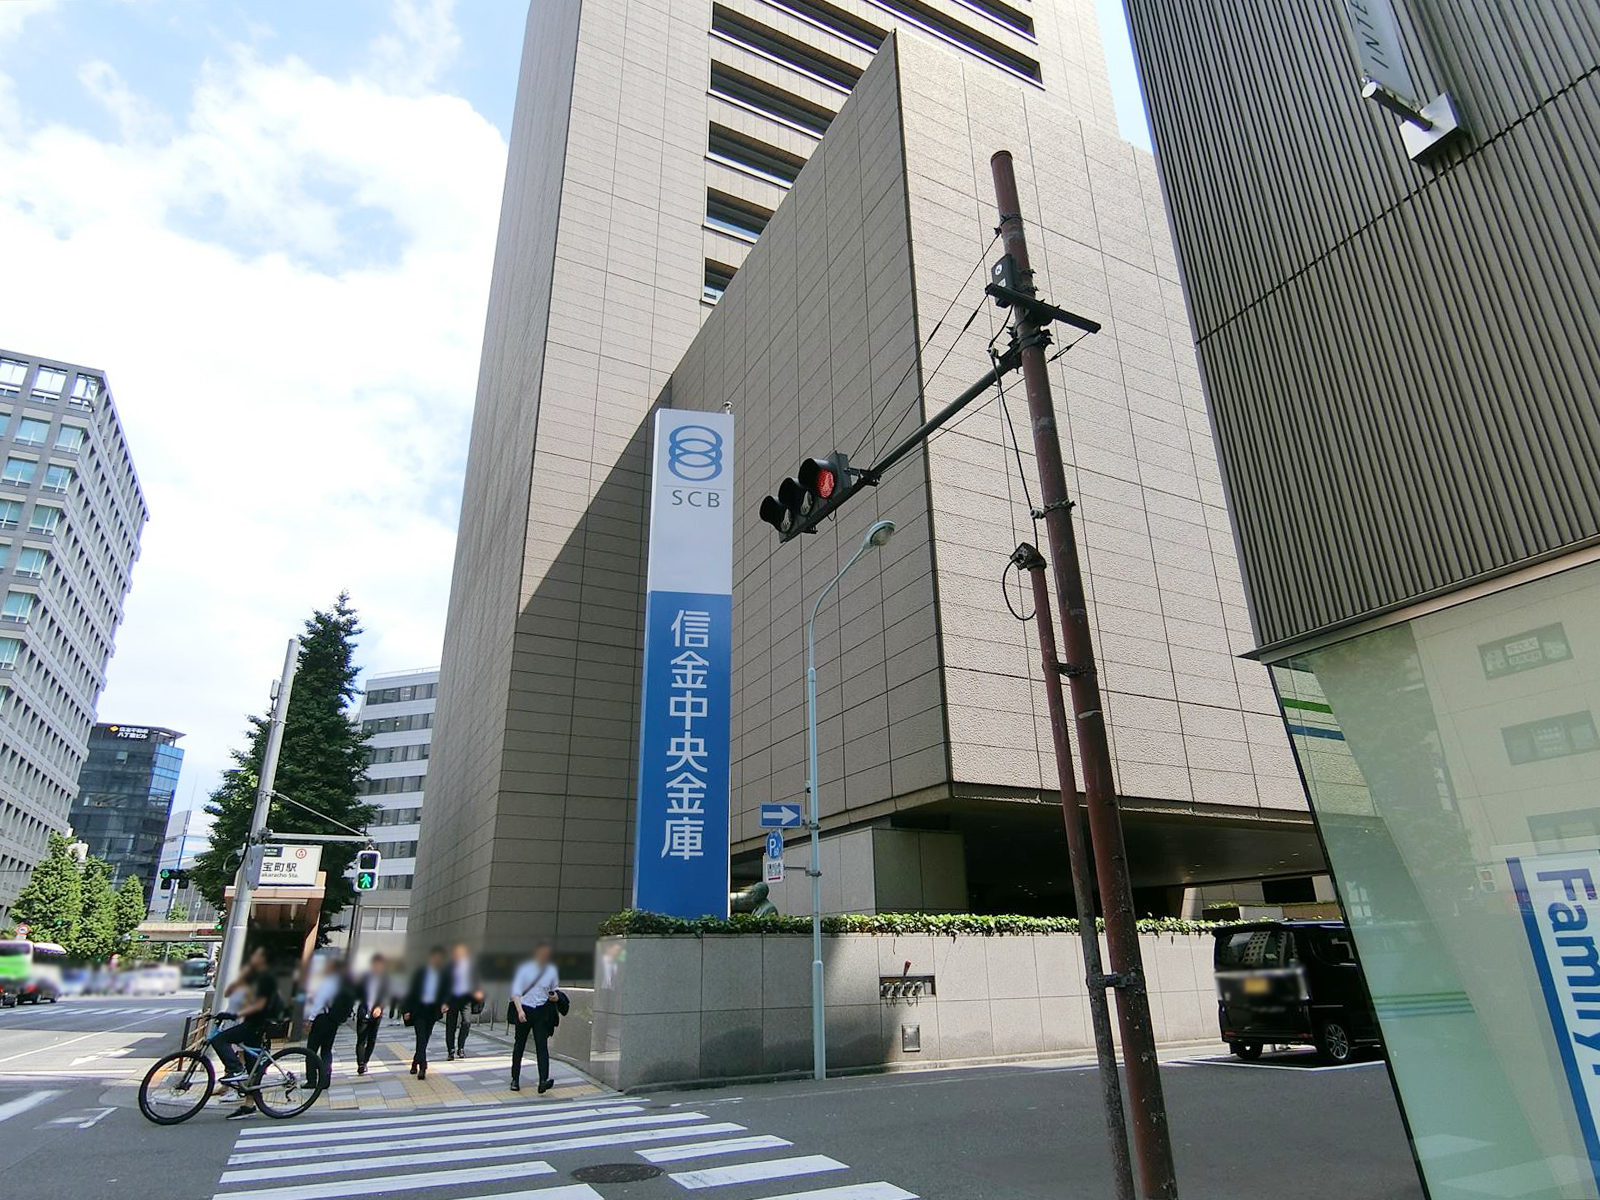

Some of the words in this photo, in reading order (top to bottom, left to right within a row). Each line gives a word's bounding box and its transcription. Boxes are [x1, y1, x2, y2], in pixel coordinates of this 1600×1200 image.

[671, 489, 720, 508] SCB
[660, 609, 711, 861] 信金中央金庫
[262, 862, 298, 872] 宝町駅
